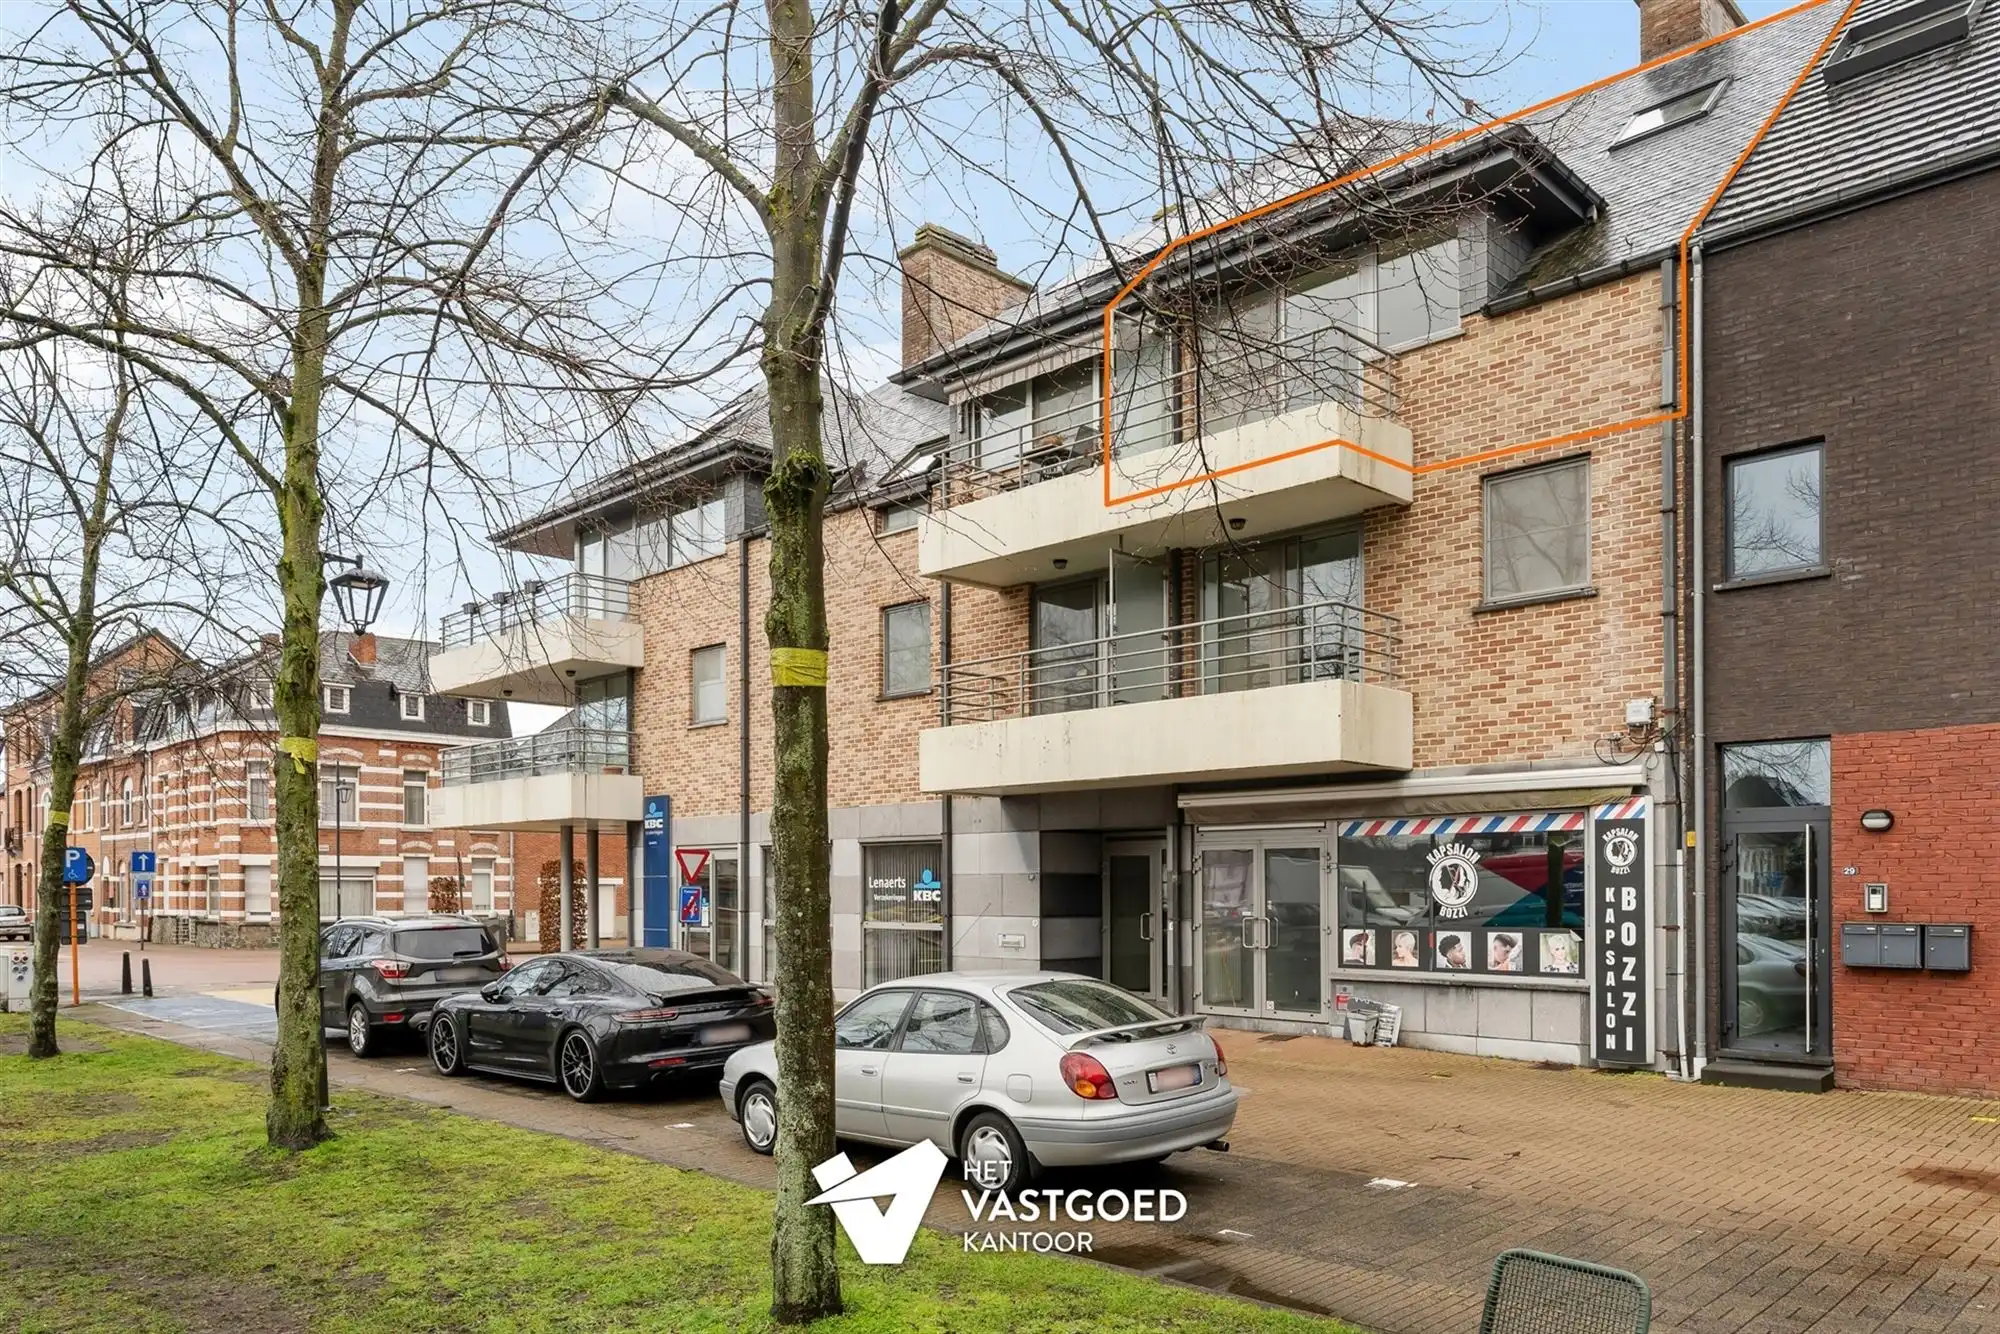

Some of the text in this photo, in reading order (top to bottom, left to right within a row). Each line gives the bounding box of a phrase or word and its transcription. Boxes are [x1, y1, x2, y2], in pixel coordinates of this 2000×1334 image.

[644, 818, 663, 829] KBC
[1602, 827, 1639, 842] KAPSALON
[66, 849, 80, 868] P
[1426, 843, 1481, 866] KAPSALON
[1610, 866, 1631, 875] BOZZI
[1844, 867, 1856, 875] 29
[868, 876, 906, 889] Lenaerts
[913, 889, 941, 902] KBC
[1439, 906, 1469, 919] BOZZI
[1605, 887, 1616, 1050] KAPSALON
[1621, 886, 1637, 1052] BOZZI
